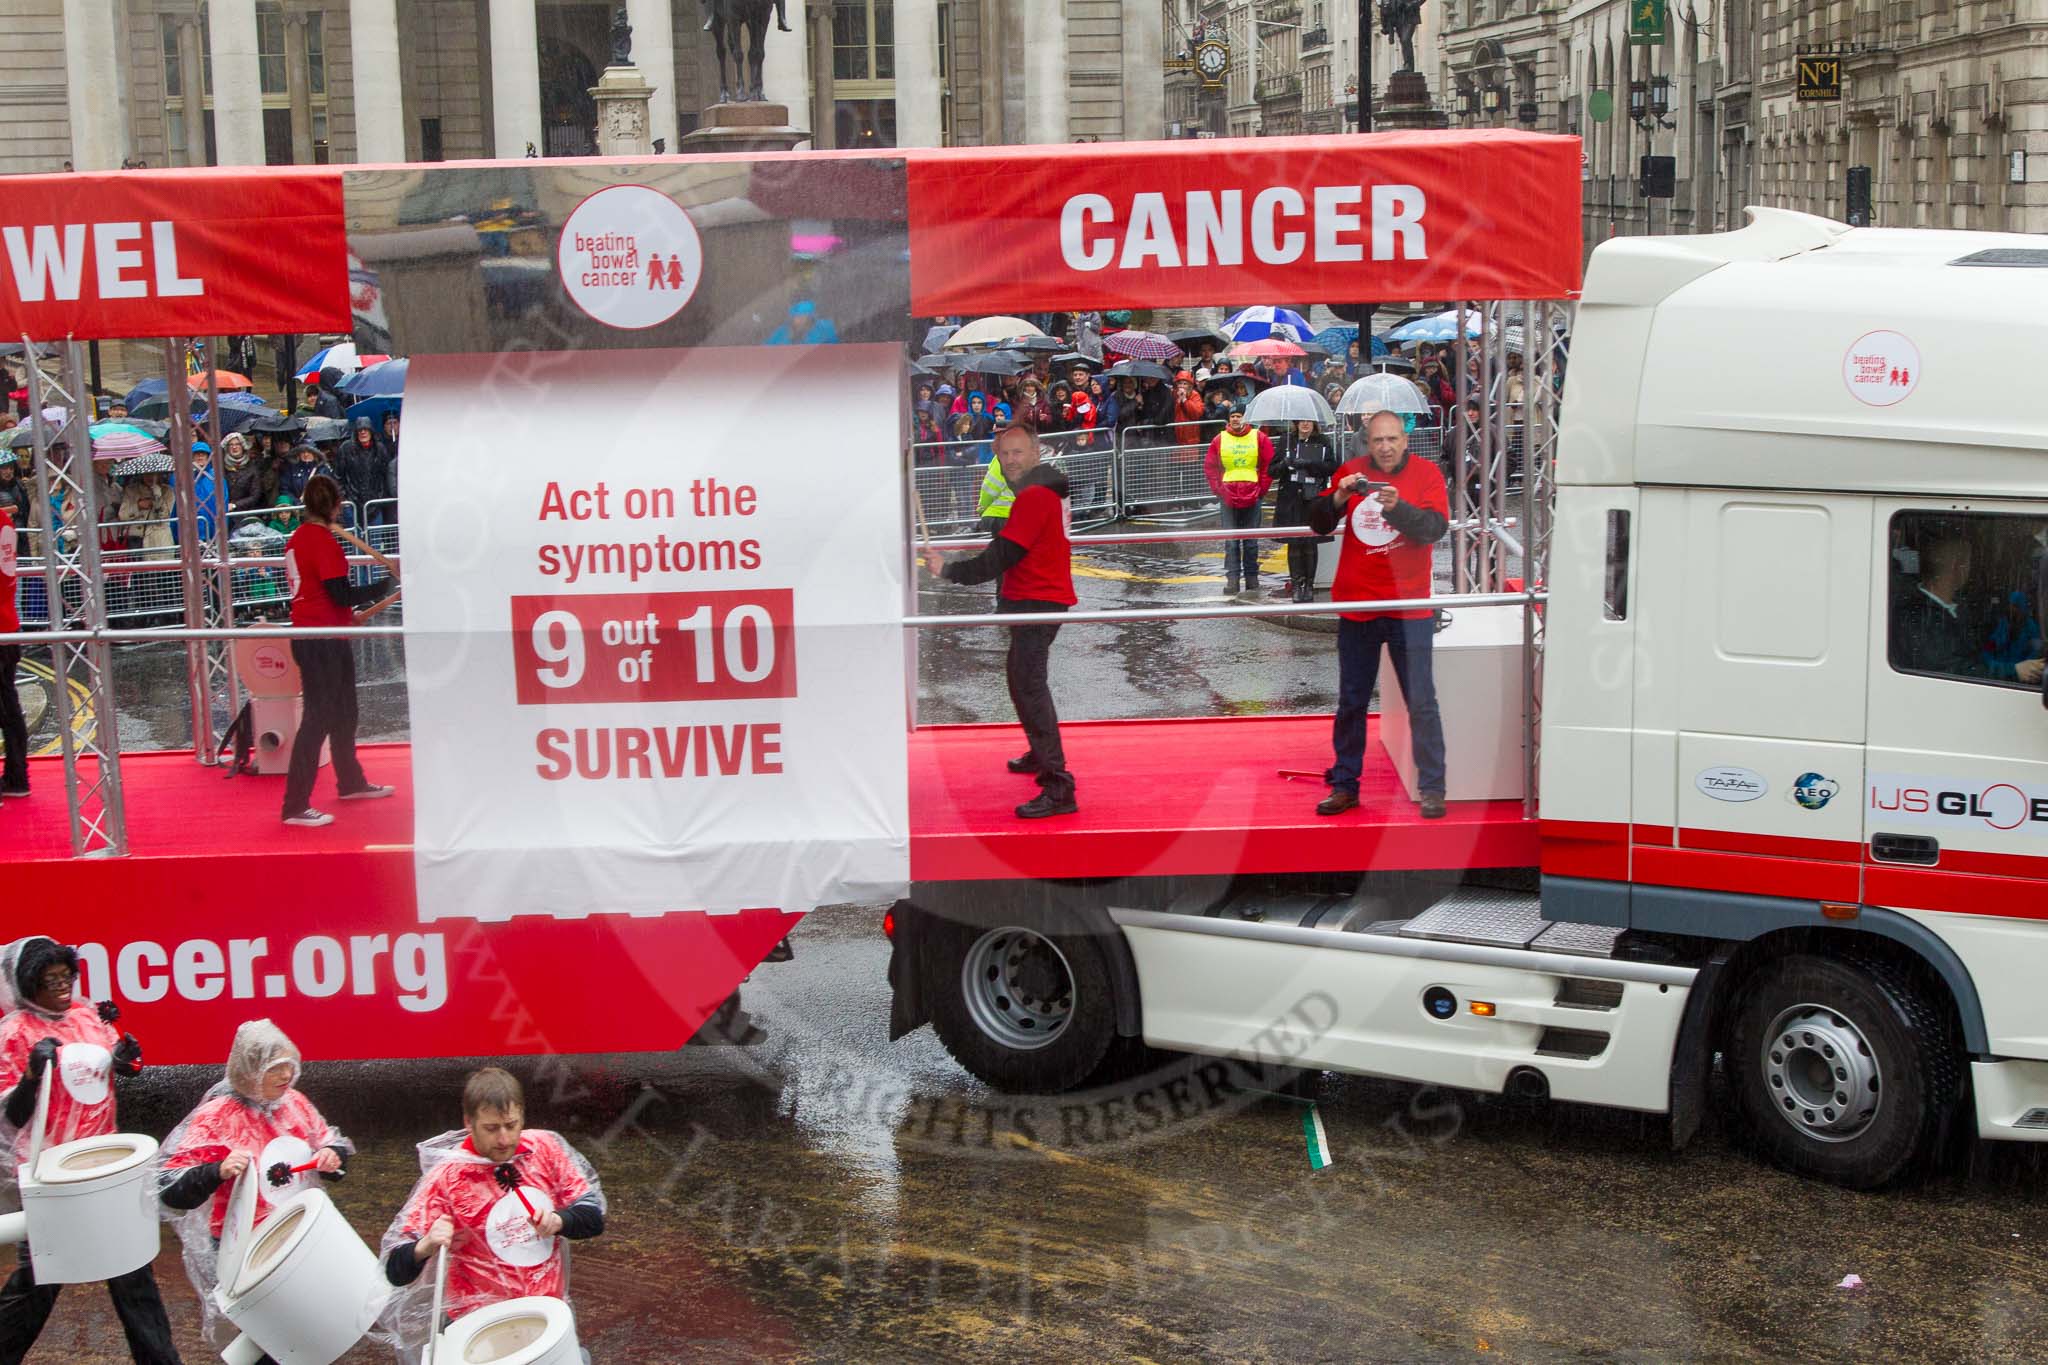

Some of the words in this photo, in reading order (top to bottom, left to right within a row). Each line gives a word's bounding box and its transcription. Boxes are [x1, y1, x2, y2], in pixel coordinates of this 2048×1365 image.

[575, 232, 638, 257] beating
[1060, 184, 1429, 271] CANCER
[591, 249, 640, 269] bowel
[581, 271, 637, 287] cancer
[538, 482, 610, 521] Act
[624, 487, 674, 518] on
[690, 477, 757, 517] the
[538, 534, 761, 584] symptoms
[602, 613, 660, 645] out
[678, 604, 776, 683] 10
[531, 610, 586, 688] 9
[618, 650, 652, 683] of
[536, 722, 783, 781] SURVIVE
[1794, 787, 1831, 798] AEO
